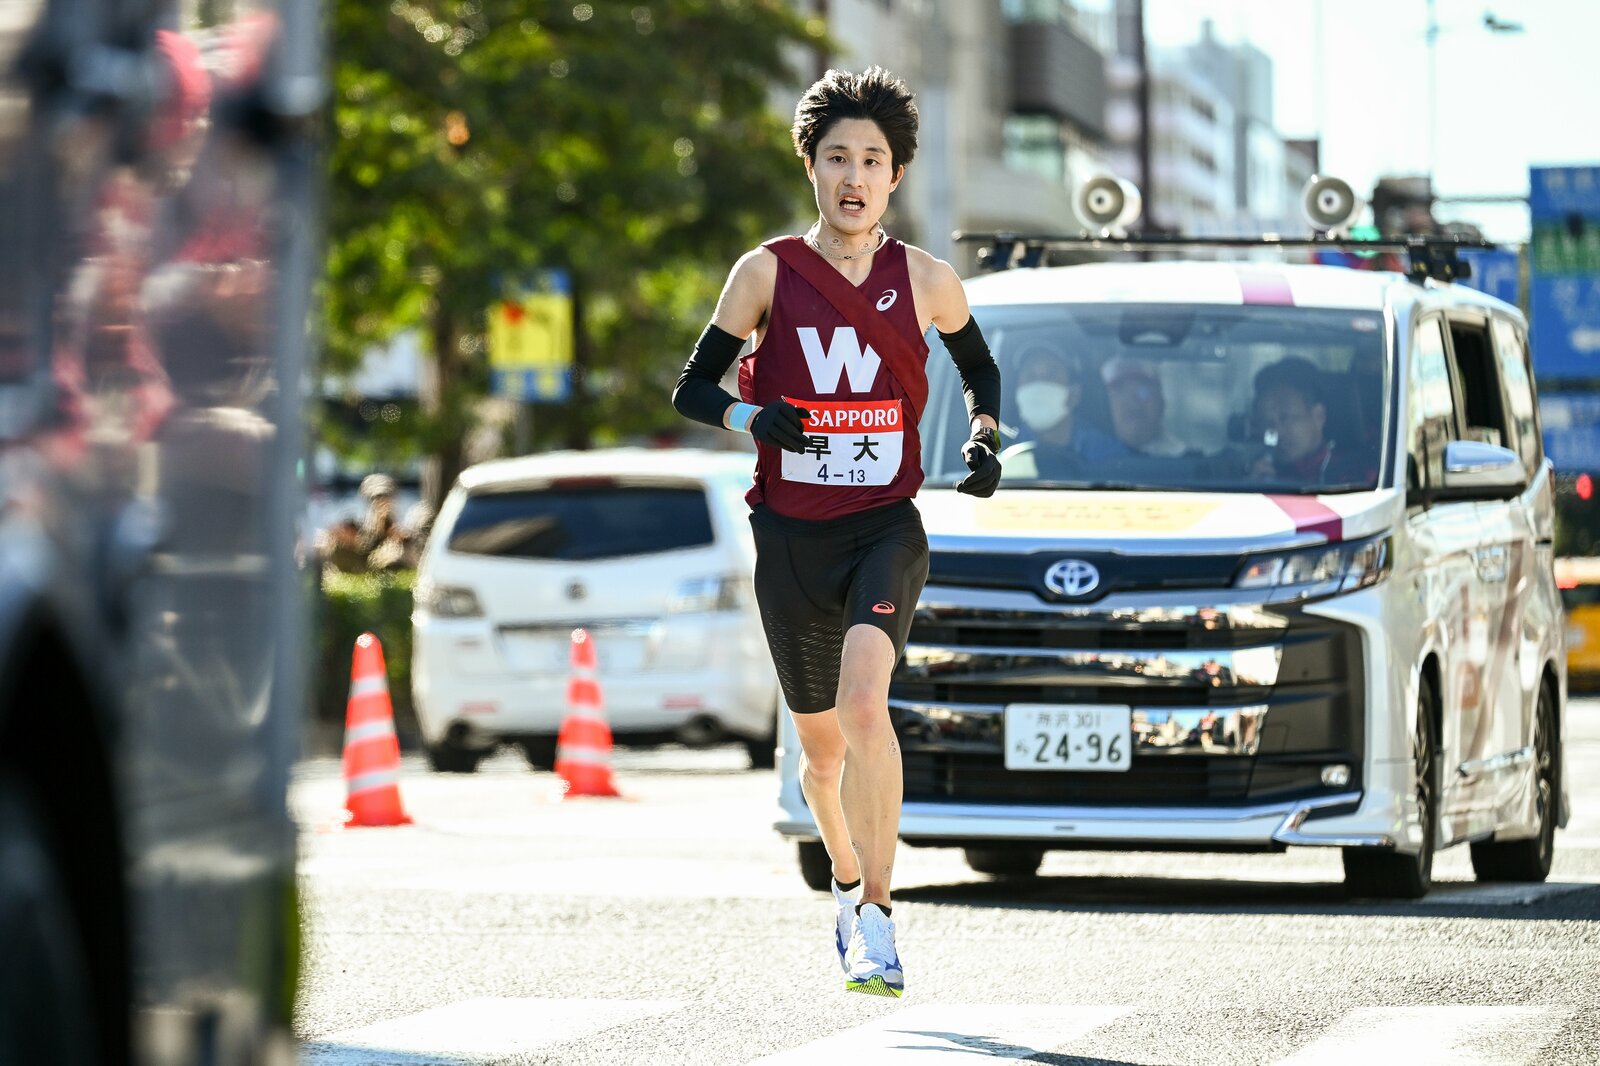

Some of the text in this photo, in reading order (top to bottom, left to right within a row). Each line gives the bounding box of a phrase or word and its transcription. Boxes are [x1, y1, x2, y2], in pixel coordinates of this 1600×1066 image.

[796, 326, 882, 394] W
[808, 407, 899, 428] SAPPORO
[817, 463, 867, 483] 4-13
[1034, 732, 1123, 763] 24-96
